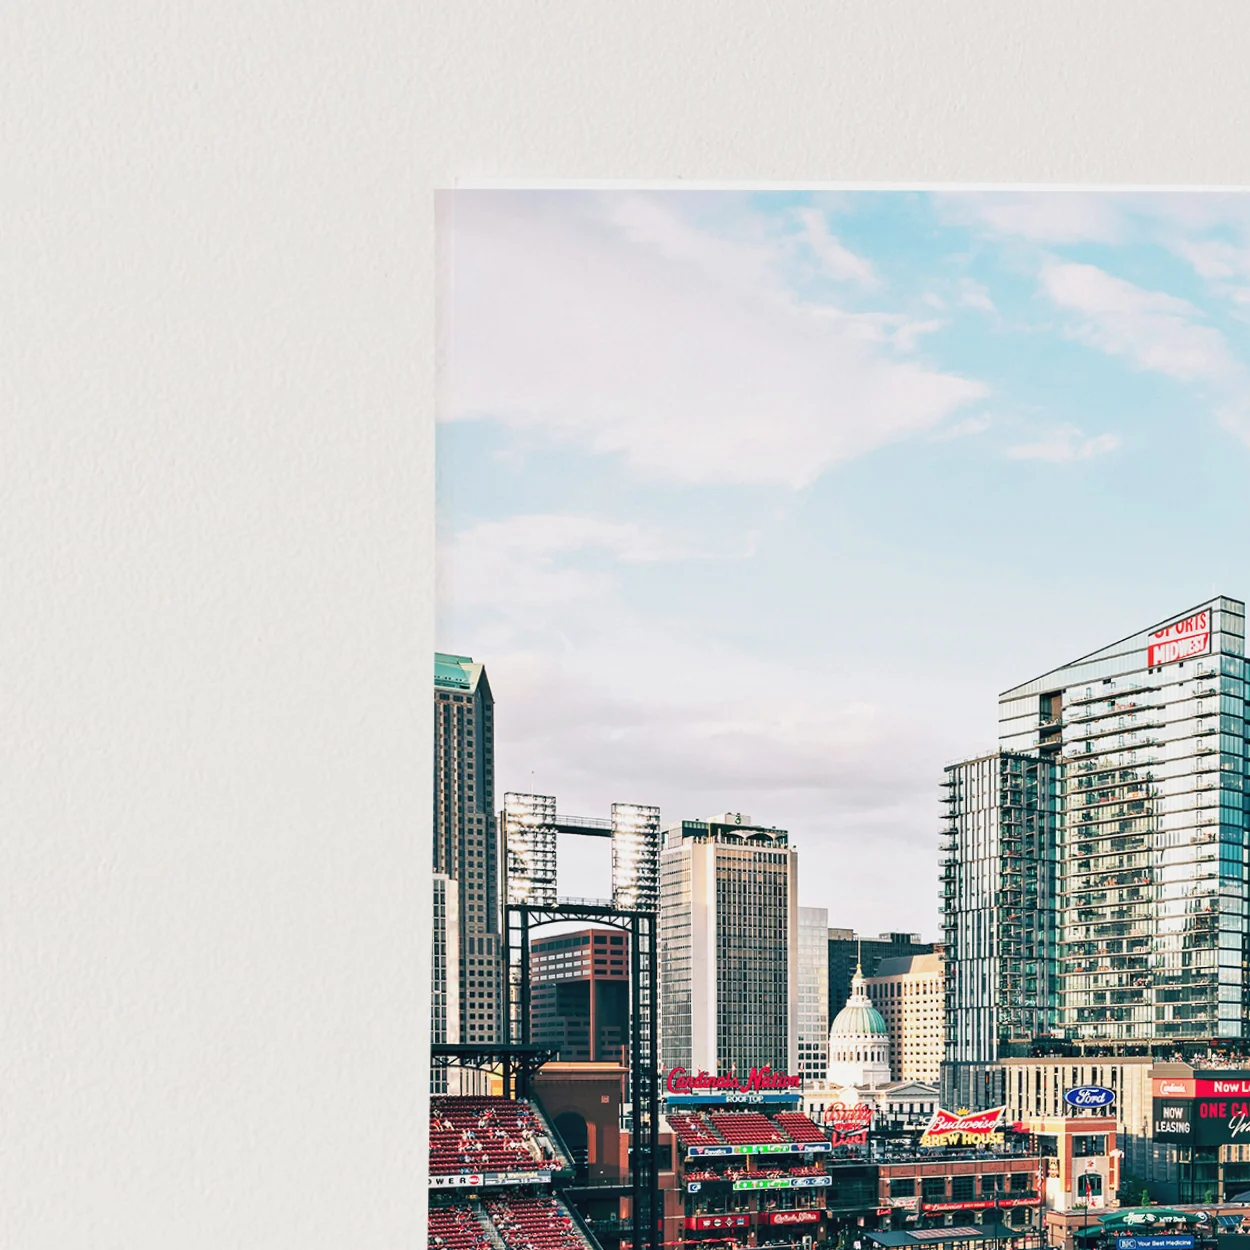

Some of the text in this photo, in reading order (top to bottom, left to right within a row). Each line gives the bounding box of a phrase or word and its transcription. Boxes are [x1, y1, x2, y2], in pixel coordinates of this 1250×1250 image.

[1153, 634, 1207, 667] MIDWEST
[666, 1067, 800, 1093] Cardinals Nation
[1160, 1080, 1186, 1095] Cardinals
[1214, 1081, 1239, 1093] Now
[726, 1095, 764, 1103] ROOFTOP
[1075, 1089, 1106, 1105] Ford
[1163, 1107, 1183, 1118] NOW
[1200, 1102, 1227, 1118] ONE
[930, 1115, 999, 1132] Budweiser
[1156, 1121, 1190, 1133] LEASING
[922, 1132, 1005, 1147] BREW HOUSE
[1121, 1239, 1134, 1248] BJC
